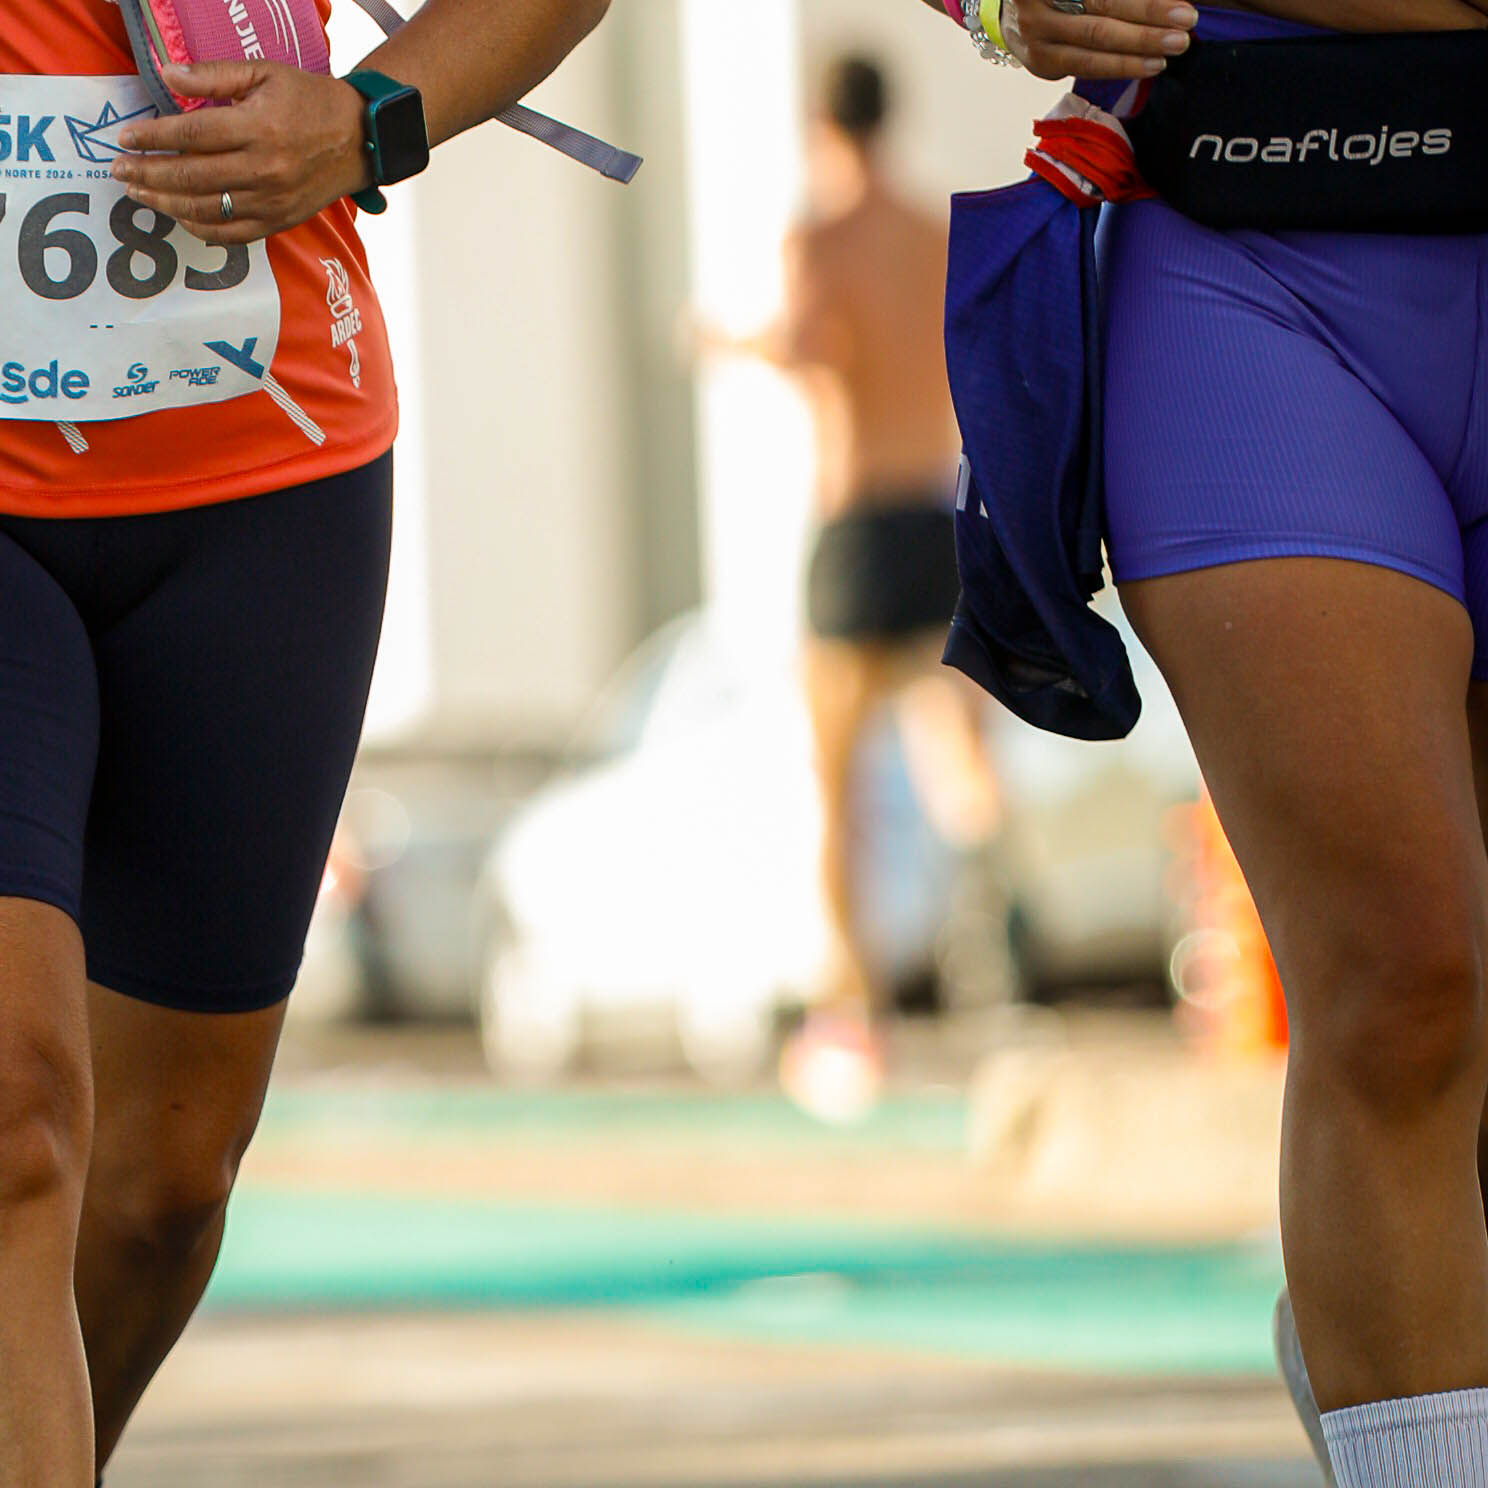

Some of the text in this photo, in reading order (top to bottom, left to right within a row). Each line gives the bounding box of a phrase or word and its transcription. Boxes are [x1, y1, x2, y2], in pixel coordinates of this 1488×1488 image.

[1189, 125, 1453, 166] noaflojes
[4, 167, 41, 179] NORTE
[46, 169, 73, 180] 2026
